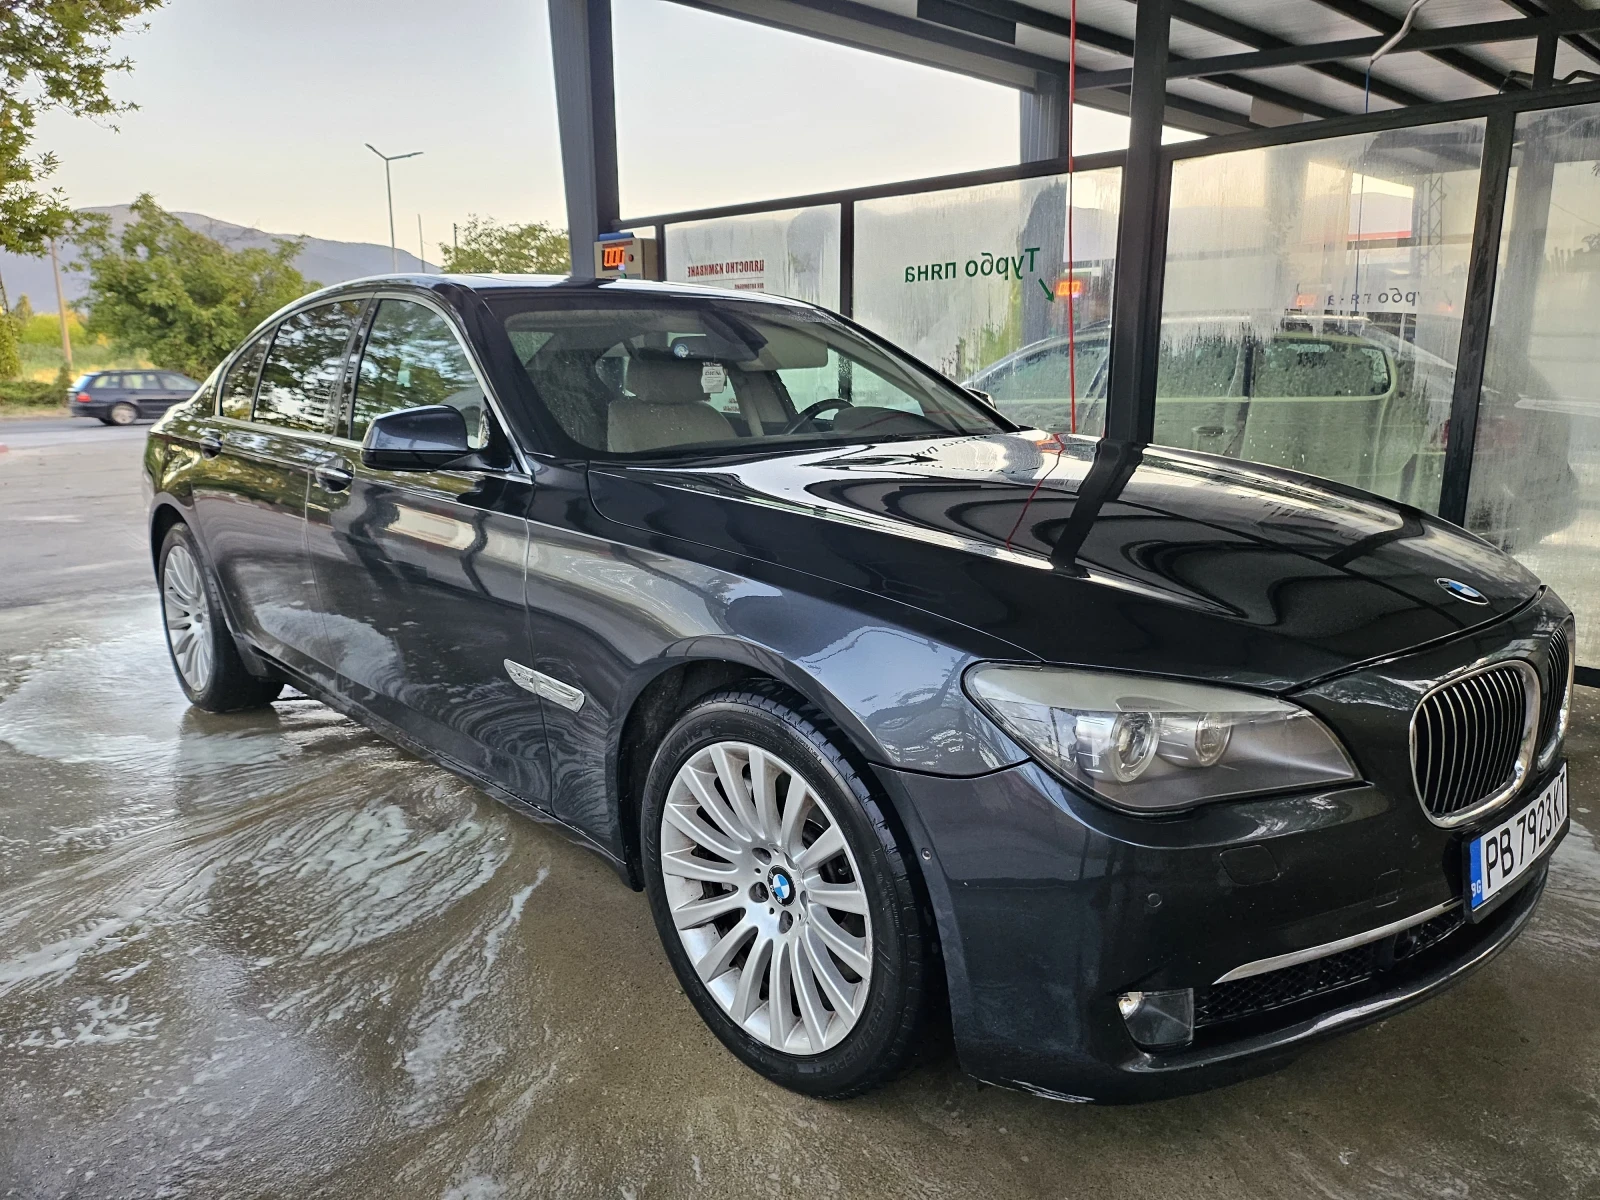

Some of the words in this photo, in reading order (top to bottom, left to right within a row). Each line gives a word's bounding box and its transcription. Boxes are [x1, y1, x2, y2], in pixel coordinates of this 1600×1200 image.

[1485, 827, 1515, 890] PB
[1516, 792, 1551, 866] 7923
[1552, 771, 1566, 828] KT
